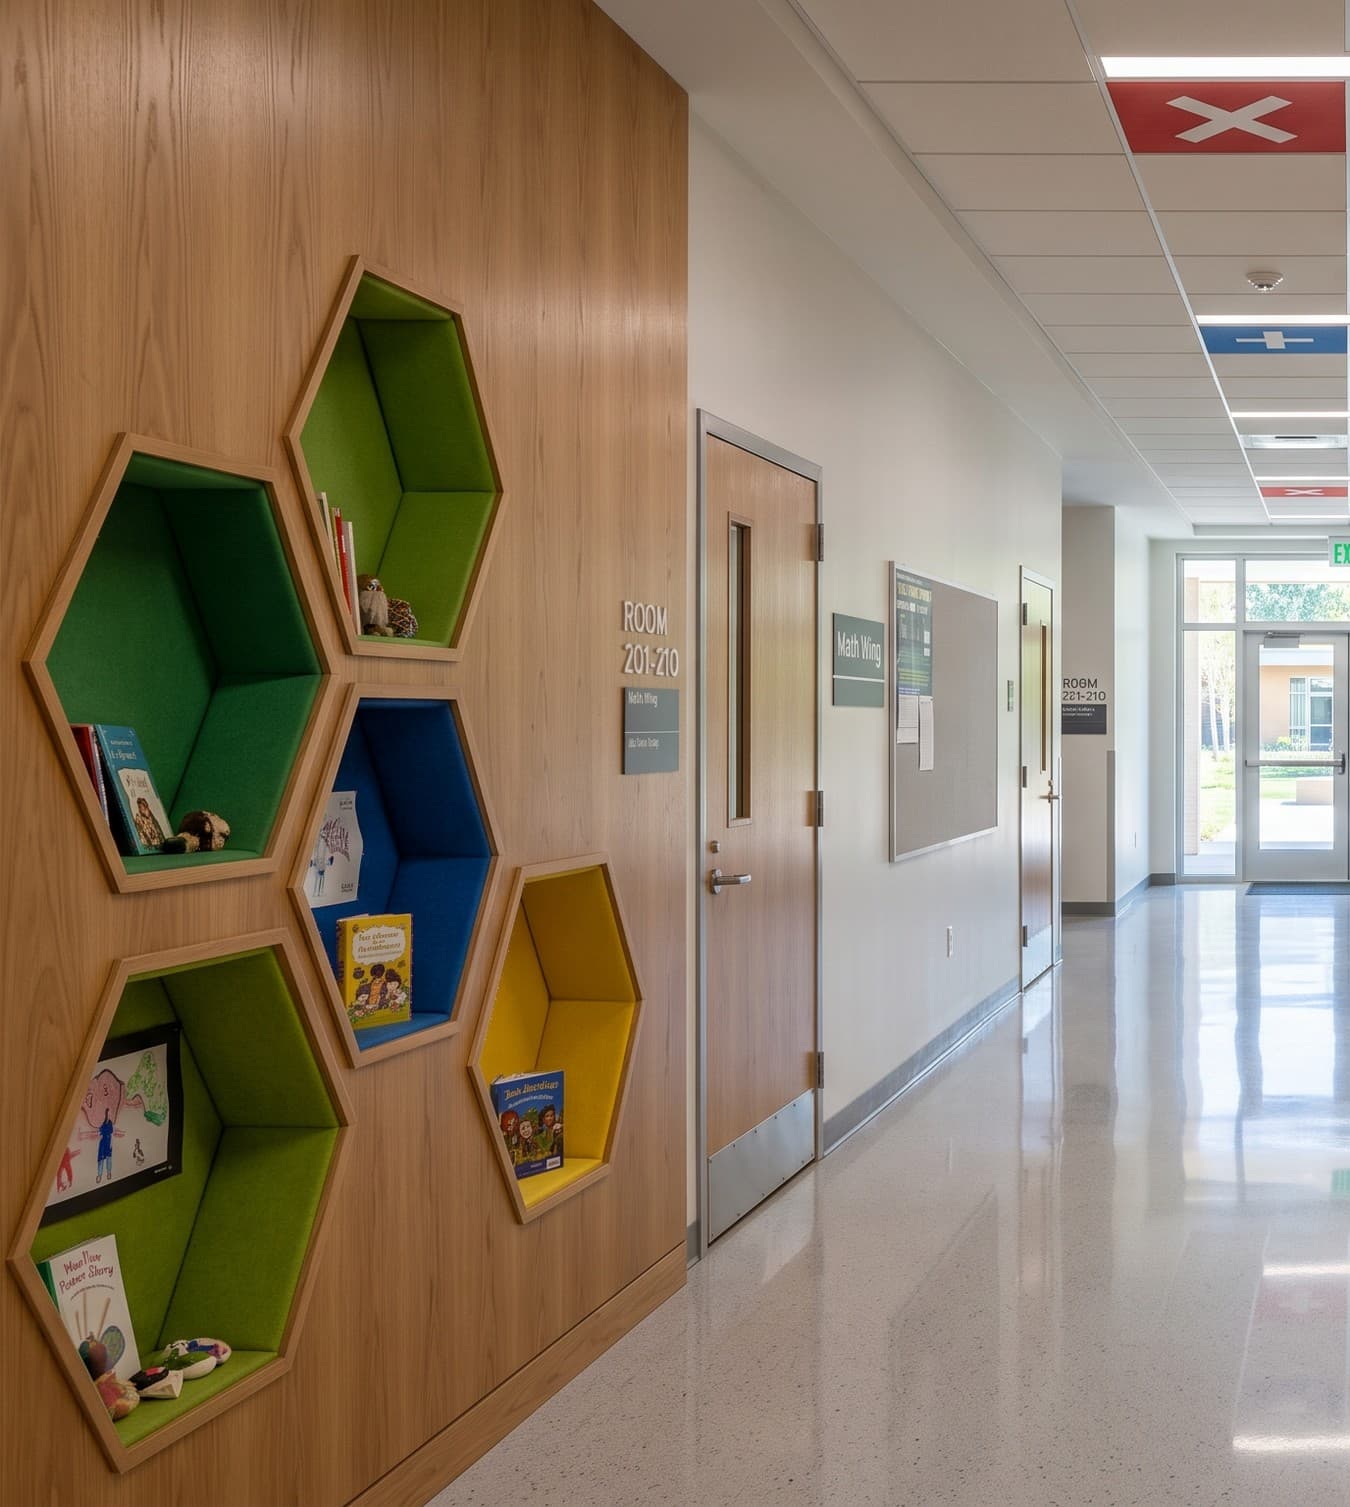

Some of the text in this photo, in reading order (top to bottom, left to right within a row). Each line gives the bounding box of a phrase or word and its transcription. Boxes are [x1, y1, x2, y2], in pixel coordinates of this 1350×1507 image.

[623, 600, 668, 636] ROOM
[623, 643, 680, 678] 201-210
[837, 631, 882, 669] Math Wing
